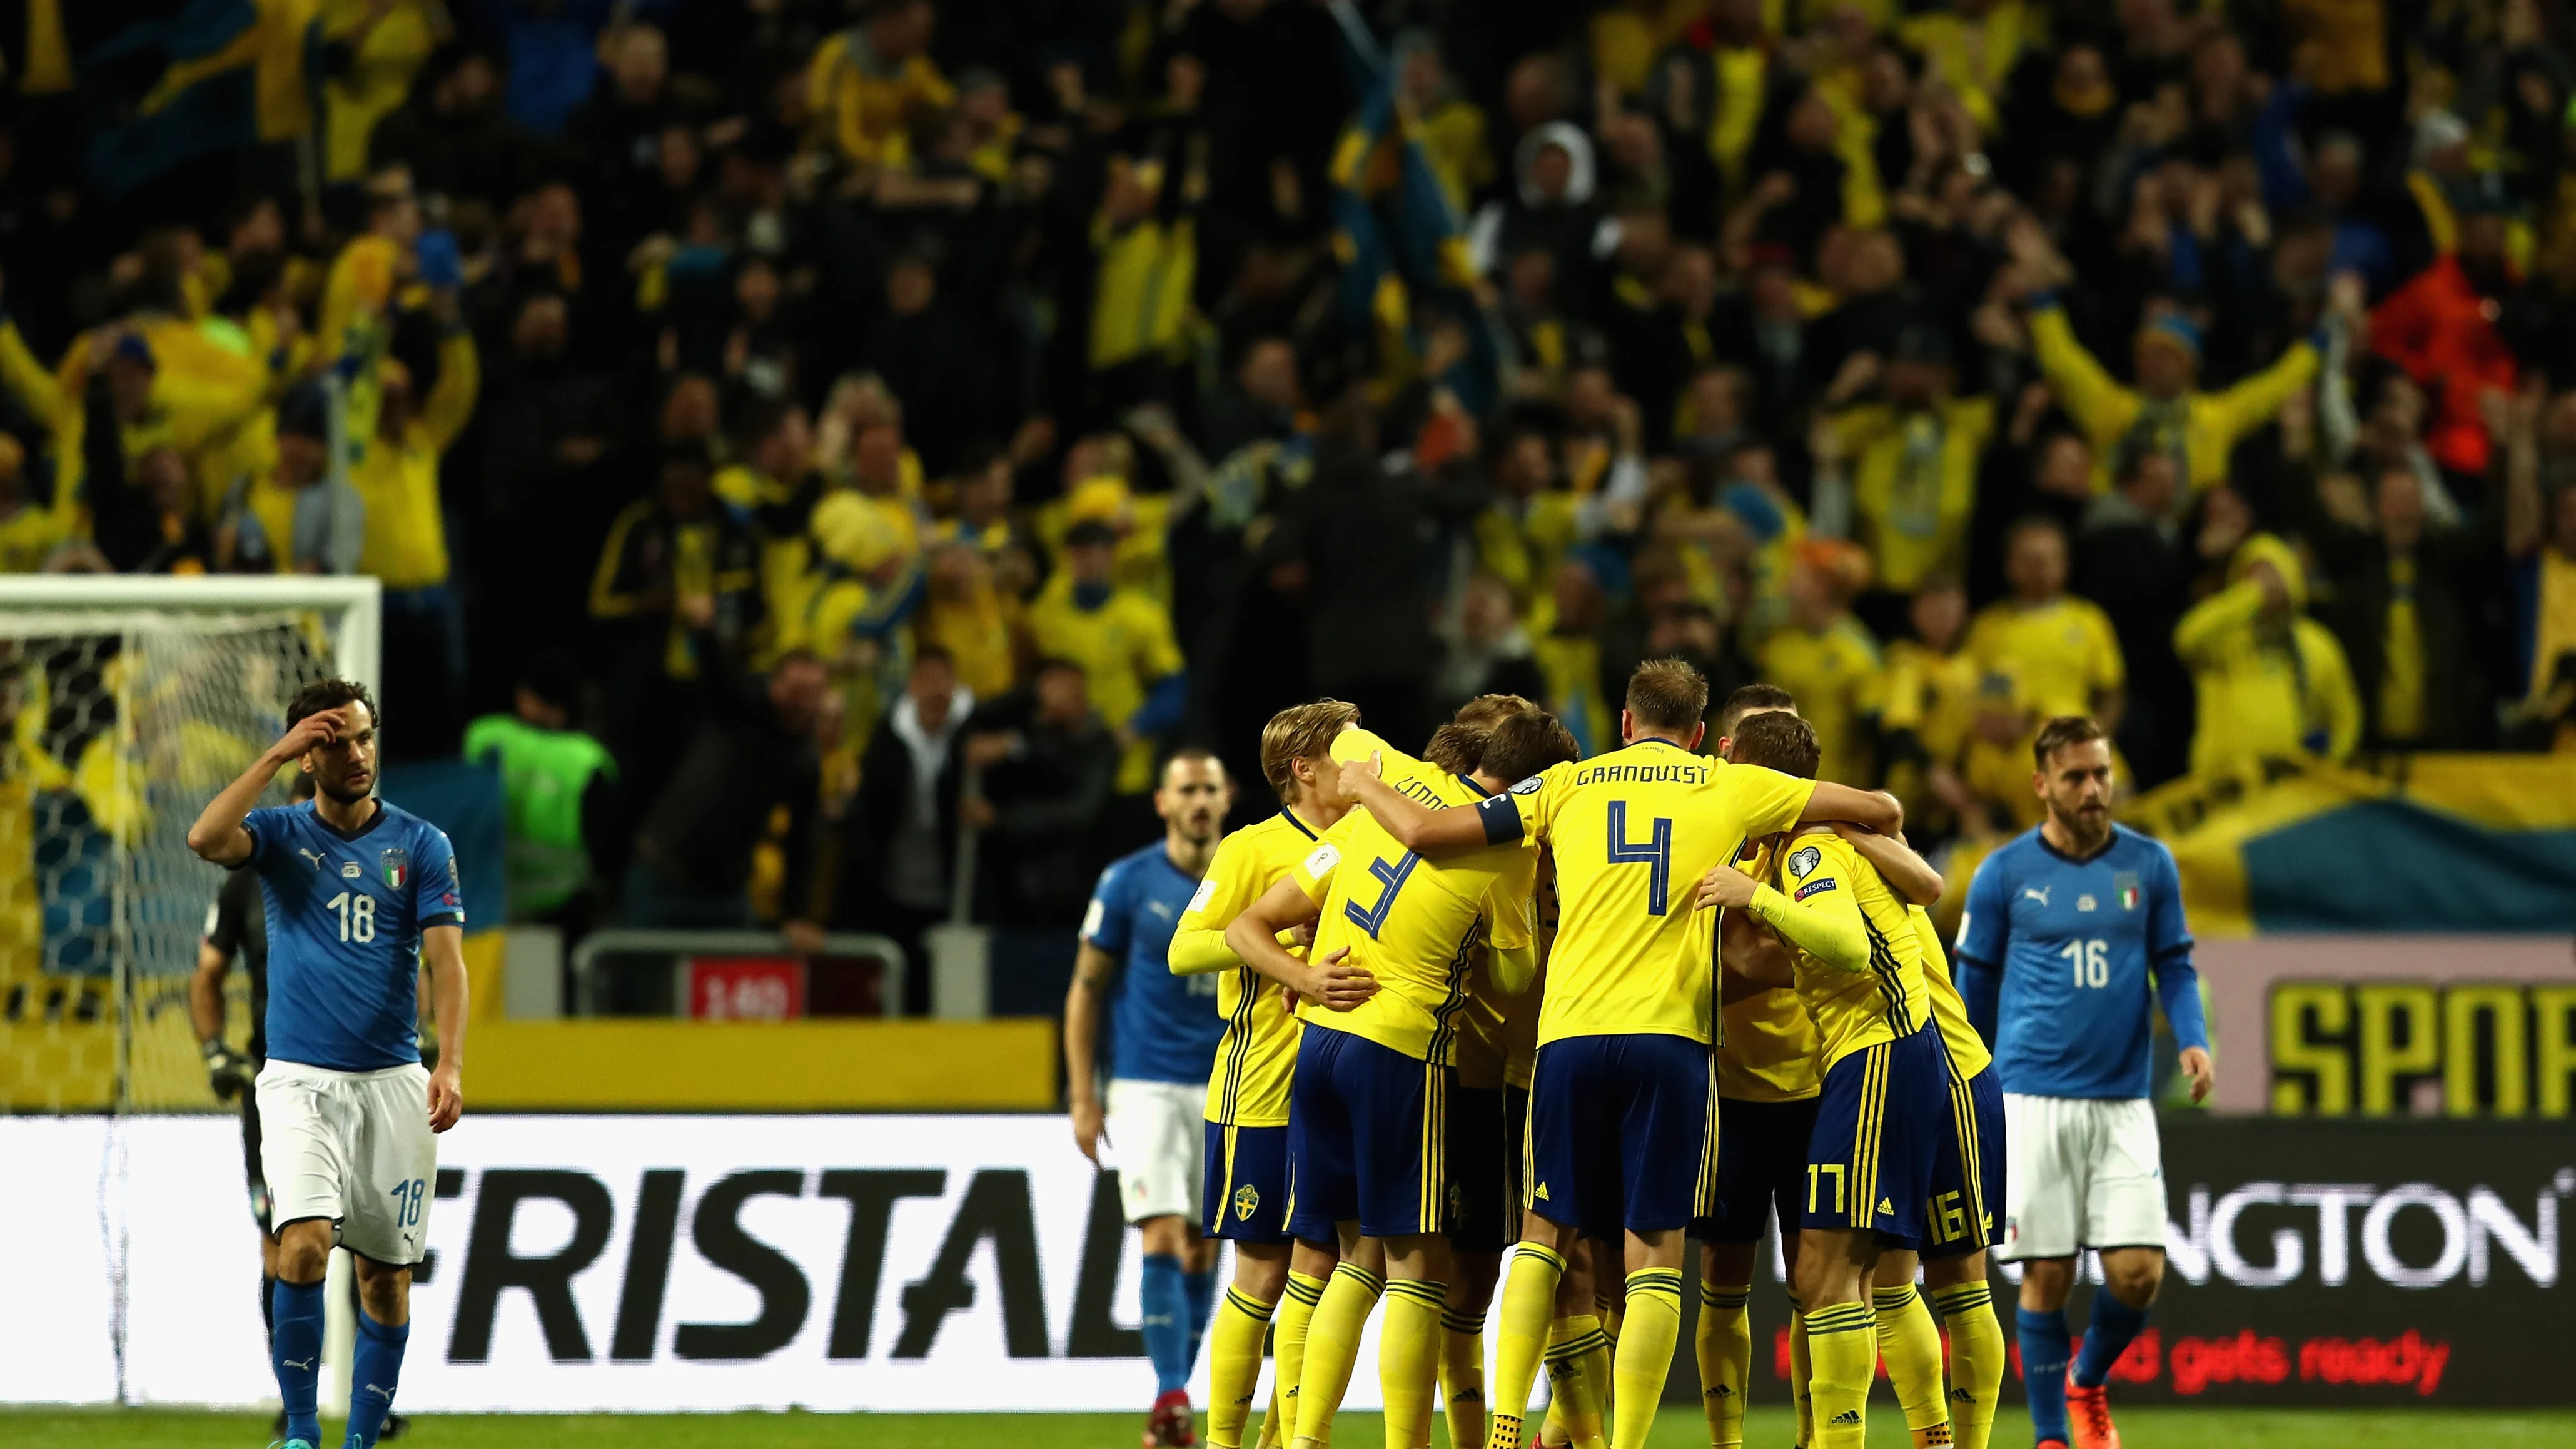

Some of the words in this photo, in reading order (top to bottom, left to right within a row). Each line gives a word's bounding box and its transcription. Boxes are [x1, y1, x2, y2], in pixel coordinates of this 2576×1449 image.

[1482, 793, 1507, 809] C
[1576, 765, 1709, 786] GRANQVIST
[1607, 800, 1672, 916] 4
[1343, 848, 1424, 941] 3
[1804, 880, 1834, 895] RESPECT
[326, 891, 376, 943] 18
[2061, 938, 2109, 988] 16
[390, 1179, 425, 1228] 18
[1807, 1164, 1844, 1213] 17
[1927, 1189, 1970, 1245] 16
[410, 1168, 1146, 1361] RISTA
[2169, 1328, 2291, 1396] gets
[2299, 1328, 2451, 1396] ready
